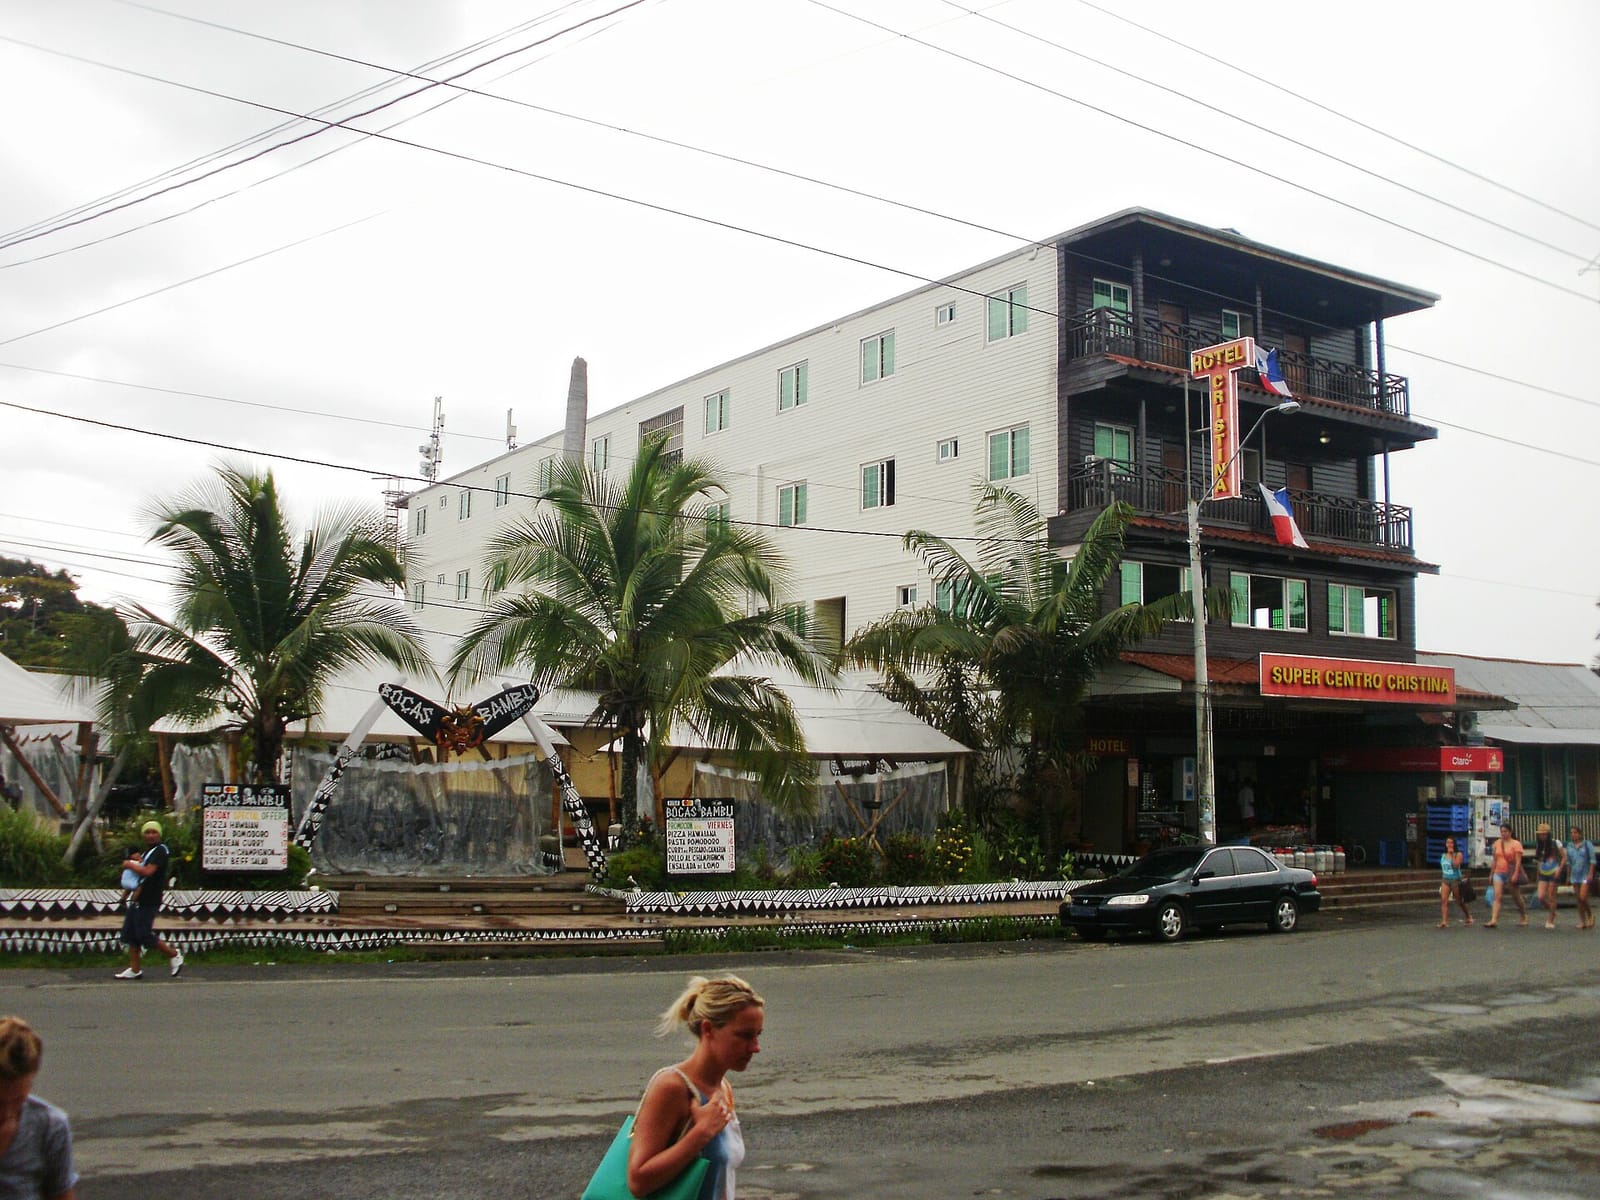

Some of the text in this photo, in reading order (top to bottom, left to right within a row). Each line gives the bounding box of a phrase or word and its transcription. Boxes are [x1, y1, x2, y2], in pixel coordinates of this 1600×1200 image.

[1192, 344, 1245, 372] HOTEL
[1212, 374, 1227, 493] CRISTINA
[1272, 666, 1449, 693] SUPER CENTRO CRISTINA
[381, 683, 537, 725] BOCAS BAMBU
[1089, 738, 1126, 752] HOTEL
[1451, 756, 1469, 766] Claro
[203, 793, 284, 806] BOCAS BAMBU
[205, 811, 231, 819] FRIDAY
[666, 805, 734, 818] BOCAS BAMBU
[707, 821, 733, 829] VIERNES
